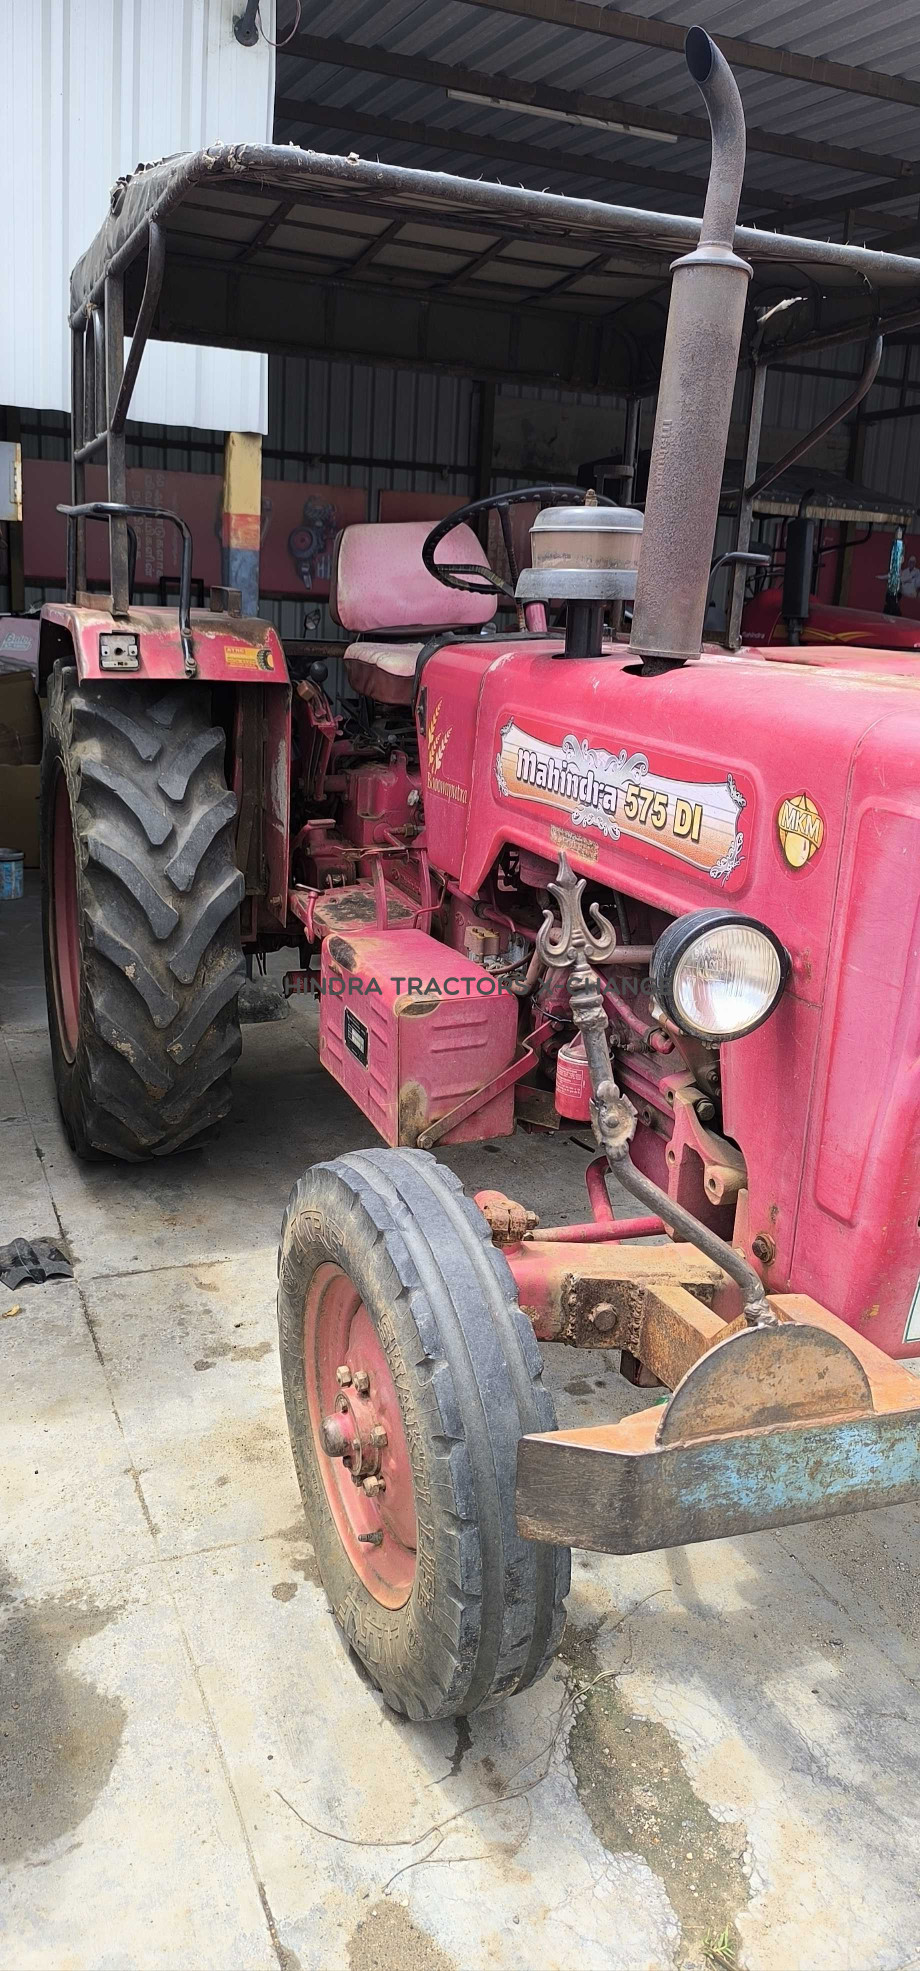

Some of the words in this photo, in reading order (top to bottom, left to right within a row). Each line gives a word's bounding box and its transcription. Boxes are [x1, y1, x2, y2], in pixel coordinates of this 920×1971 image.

[515, 747, 619, 813] Mahindra
[623, 783, 668, 829] 575
[673, 797, 704, 843] DI
[780, 801, 821, 844] MKM
[377, 1311, 432, 1506] SHAKTI
